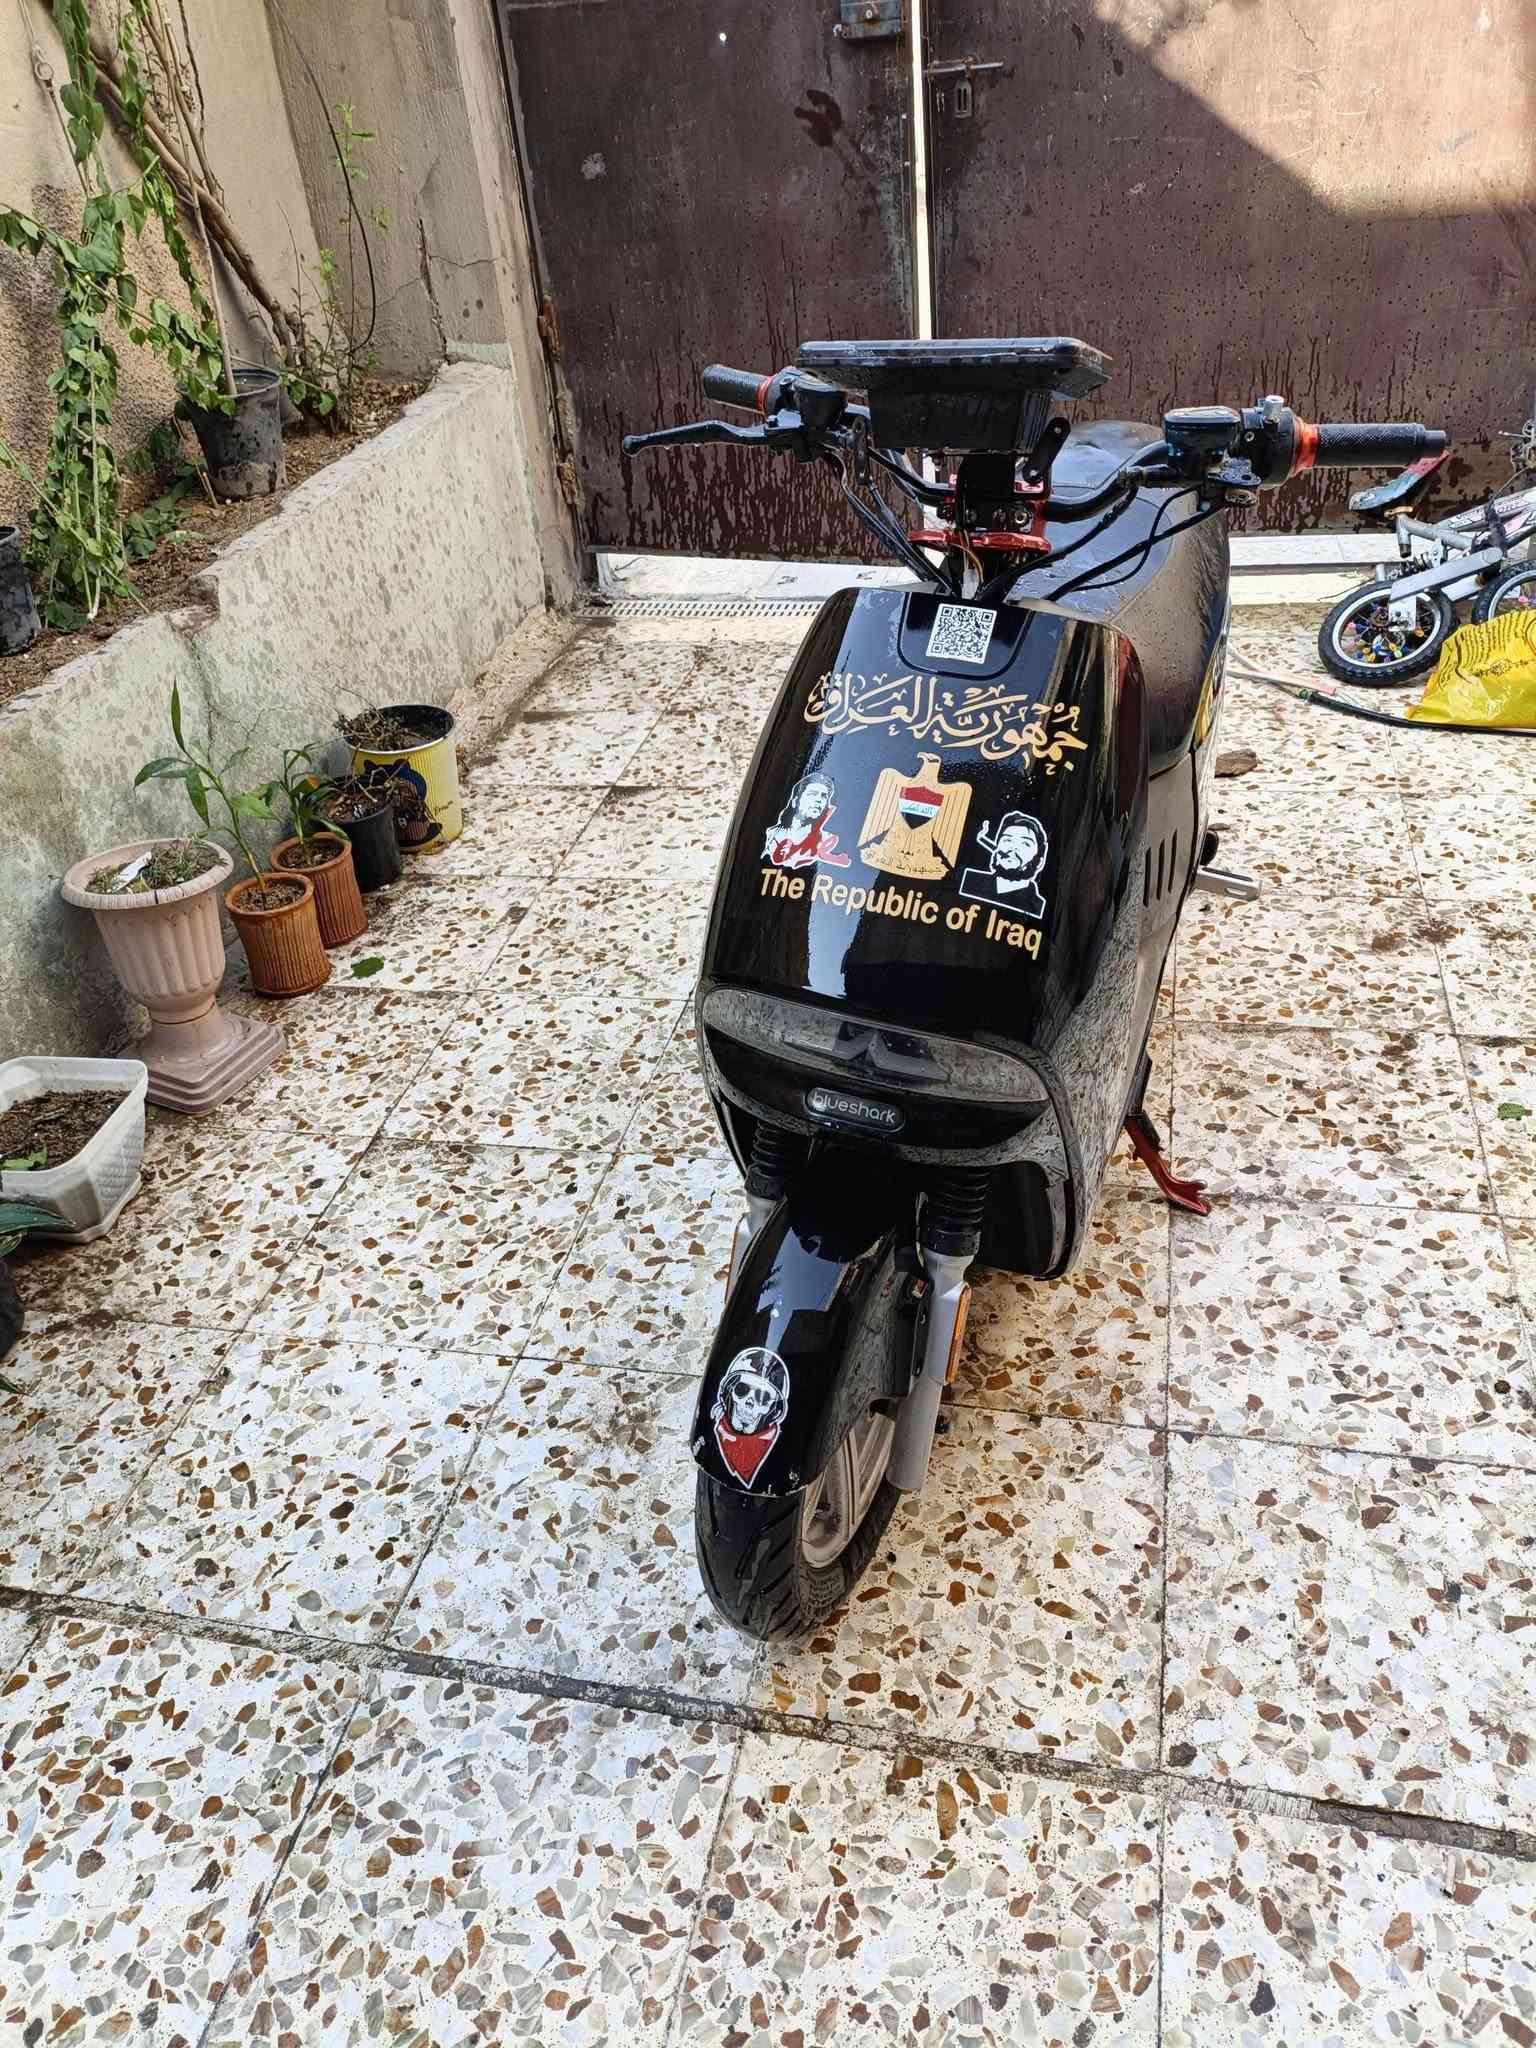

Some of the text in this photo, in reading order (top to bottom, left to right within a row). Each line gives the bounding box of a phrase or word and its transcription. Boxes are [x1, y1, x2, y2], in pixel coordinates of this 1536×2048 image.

[760, 868, 1043, 961] The Republic of Iraq
[812, 1091, 896, 1123] blueshark
